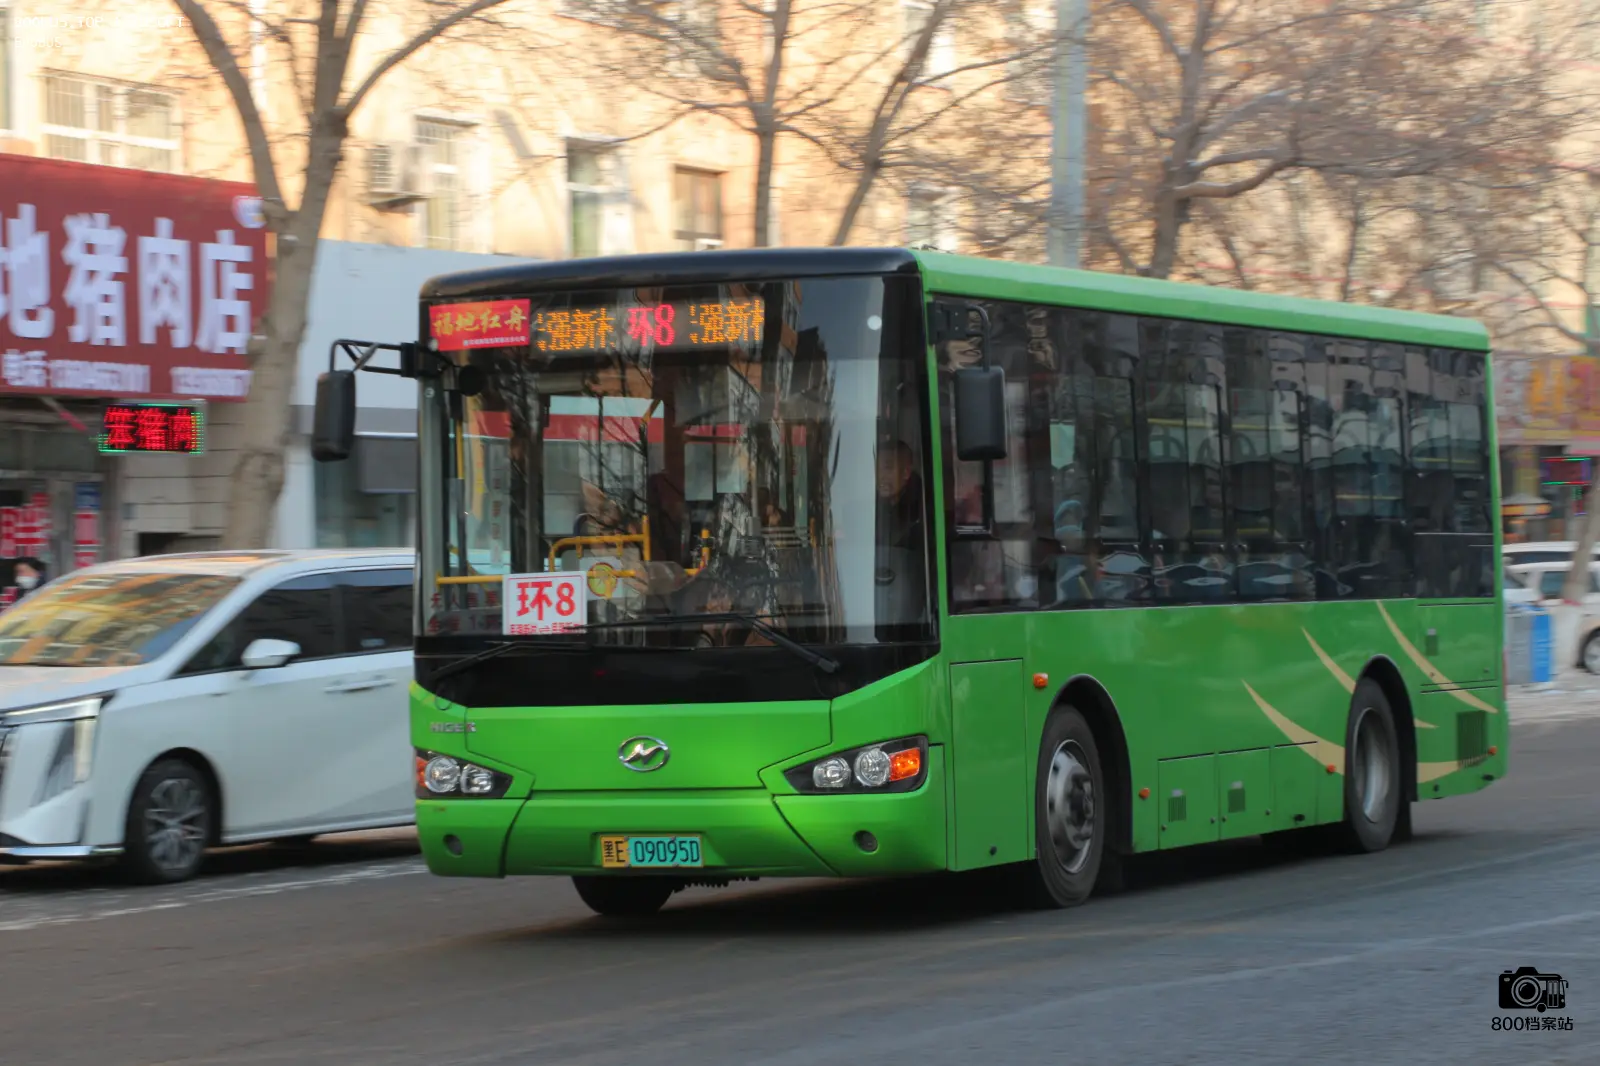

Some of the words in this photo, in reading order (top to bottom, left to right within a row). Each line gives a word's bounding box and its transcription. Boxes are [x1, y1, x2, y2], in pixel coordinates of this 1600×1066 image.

[0, 203, 253, 354] 地猪肉店
[627, 303, 676, 347] 环8
[516, 581, 577, 621] 环8
